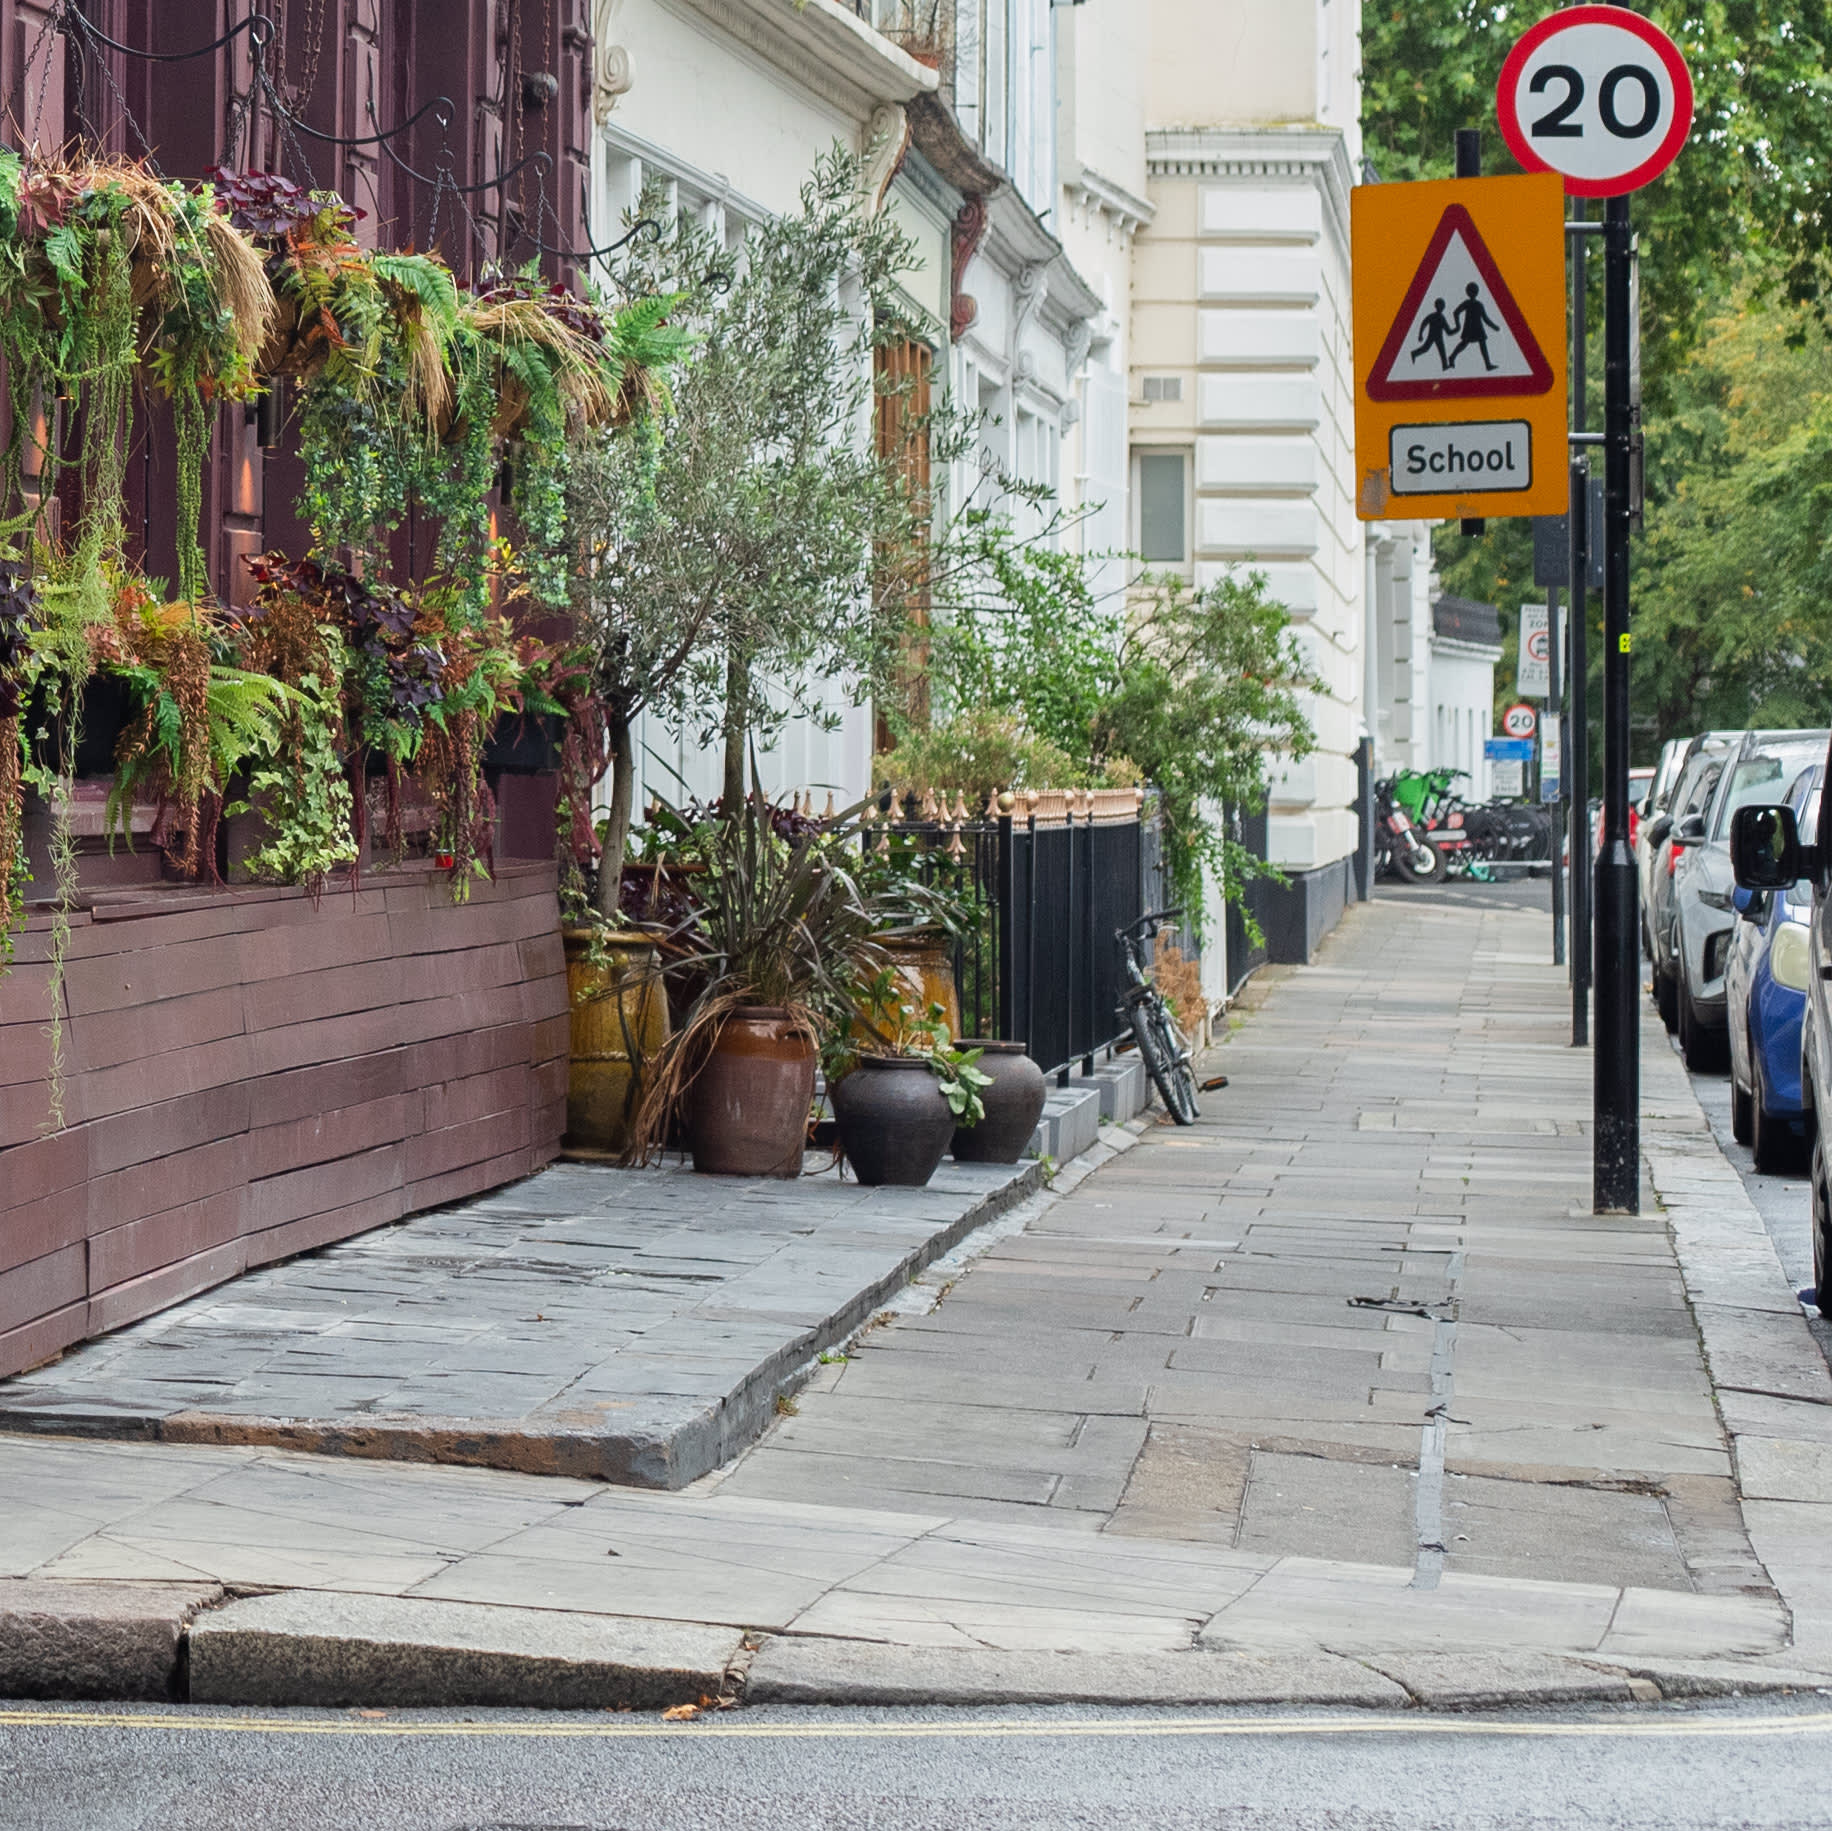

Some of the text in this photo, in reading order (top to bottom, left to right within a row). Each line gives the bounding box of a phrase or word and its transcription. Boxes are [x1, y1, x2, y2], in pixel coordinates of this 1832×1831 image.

[1528, 63, 1662, 140] 20
[1405, 439, 1516, 476] School
[1510, 714, 1534, 729] 20
